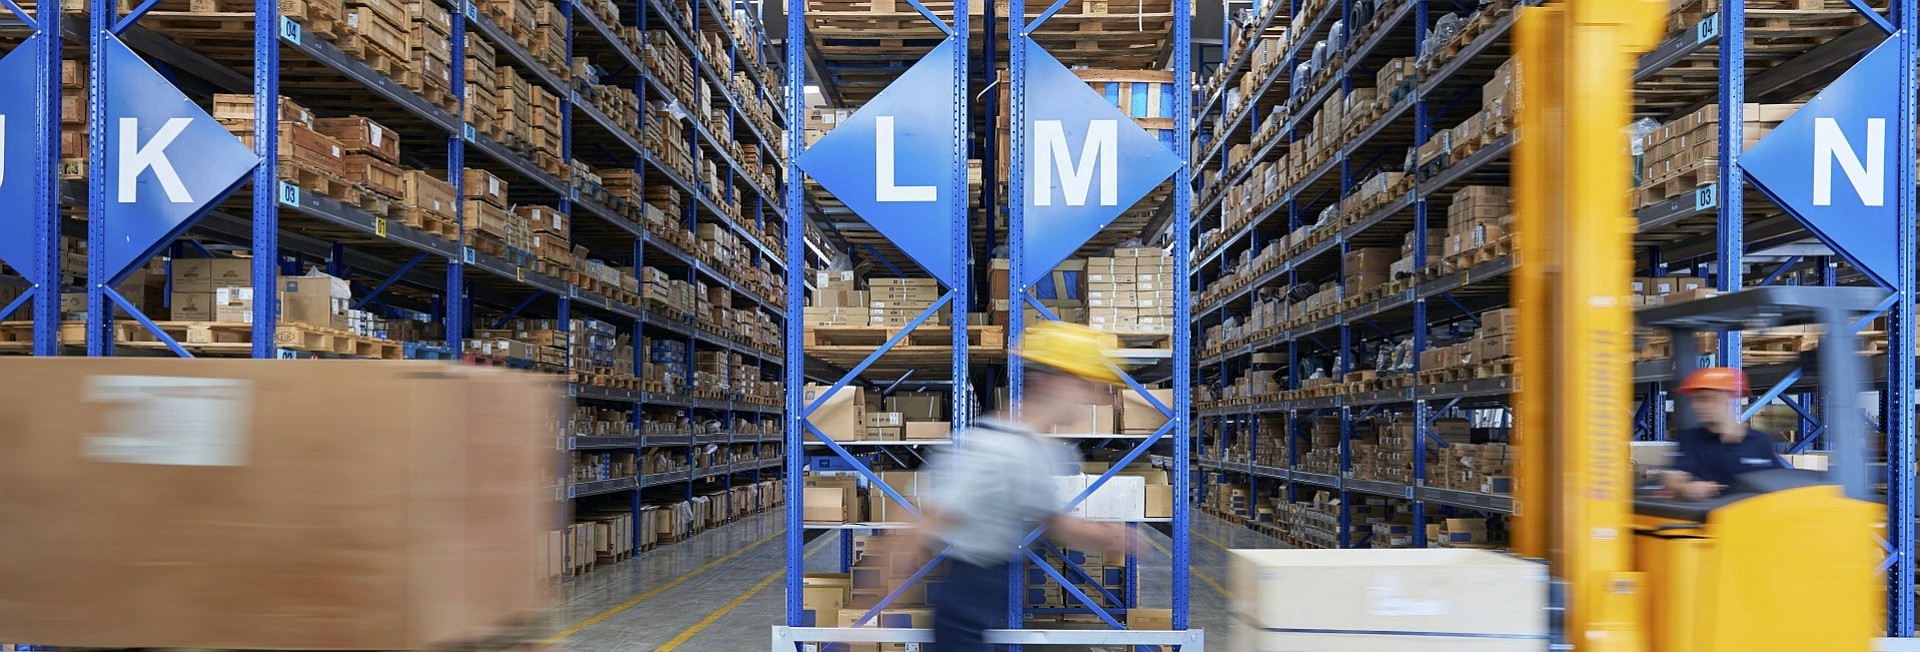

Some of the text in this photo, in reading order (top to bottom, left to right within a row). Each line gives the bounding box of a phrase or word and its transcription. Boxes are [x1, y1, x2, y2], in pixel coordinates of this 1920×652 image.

[286, 21, 296, 39] 04
[1702, 18, 1713, 38] 04
[118, 117, 194, 203] K
[875, 116, 937, 202] L
[1033, 120, 1118, 206] M
[1812, 117, 1886, 207] N
[284, 185, 295, 203] 03
[1700, 188, 1711, 206] 03
